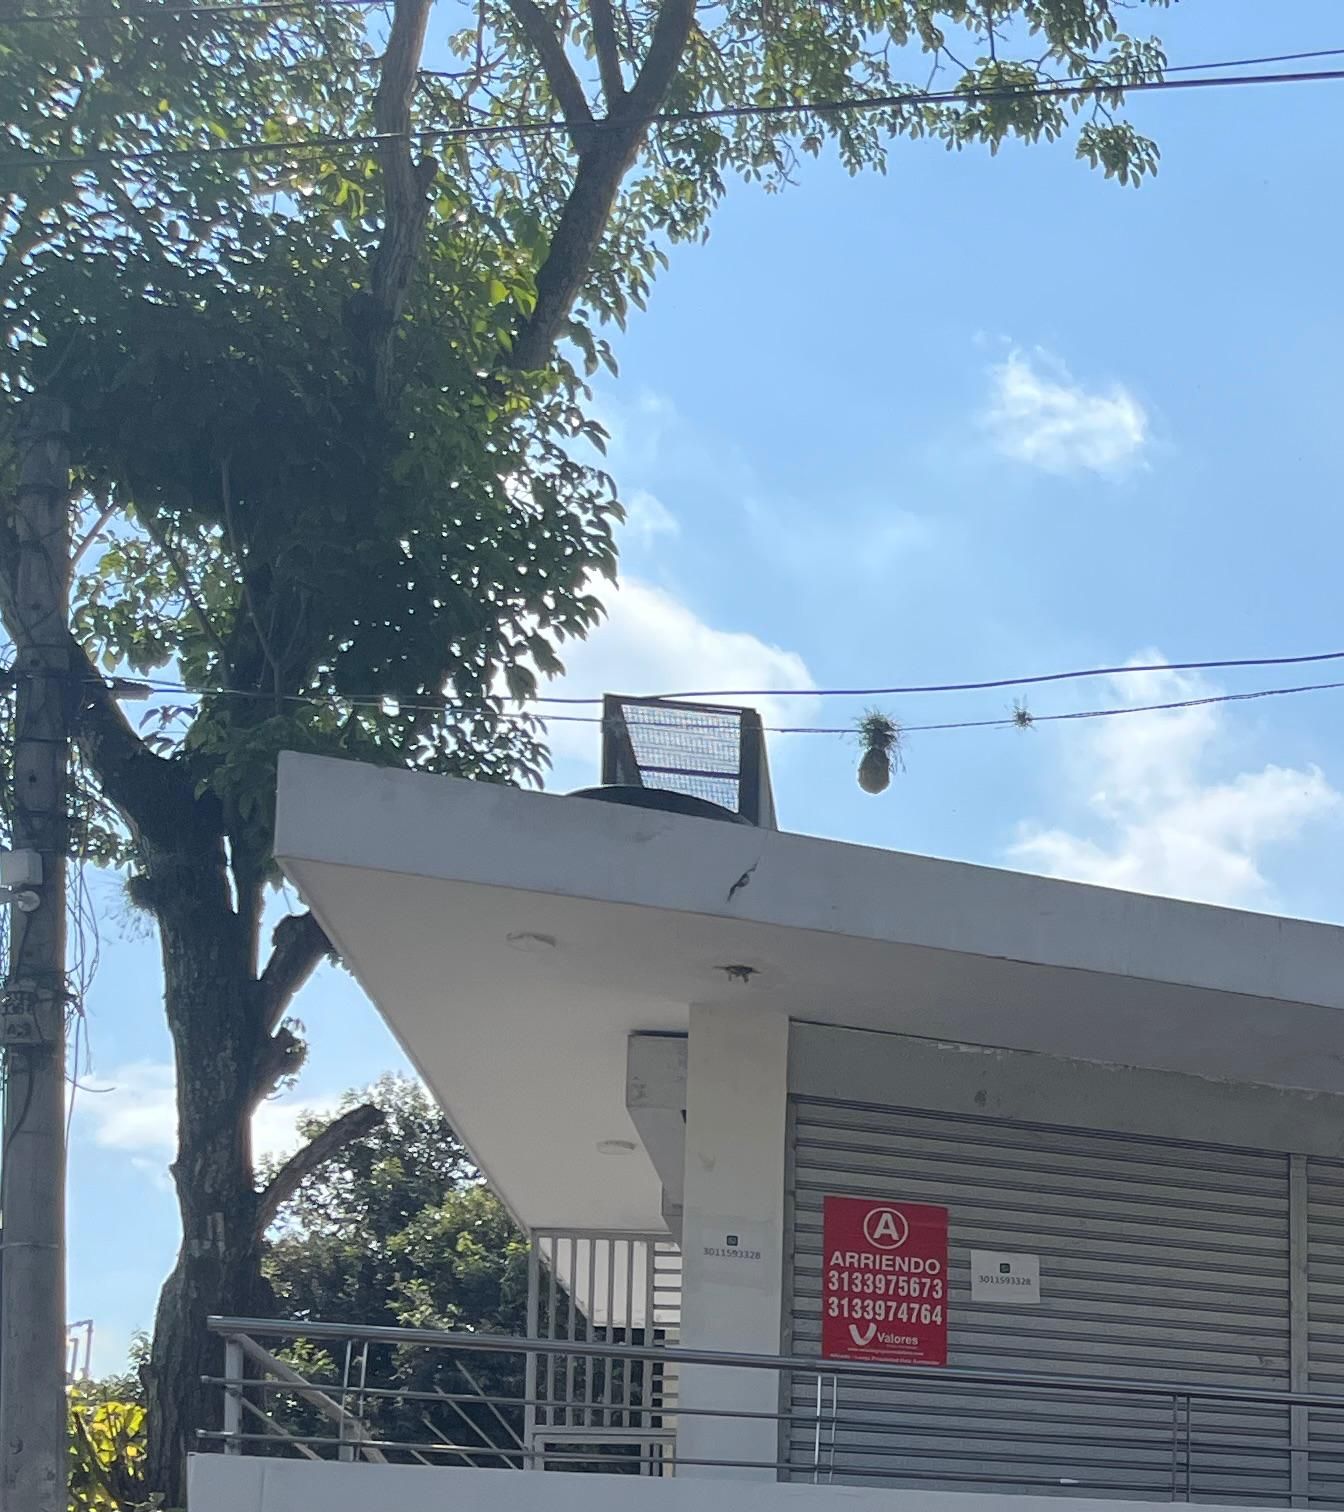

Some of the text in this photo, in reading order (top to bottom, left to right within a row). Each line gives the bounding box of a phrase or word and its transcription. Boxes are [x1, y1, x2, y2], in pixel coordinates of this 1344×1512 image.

[872, 1212, 900, 1241] A
[829, 1250, 941, 1275] ARRIENDO
[827, 1270, 943, 1299] 3133975673
[827, 1296, 943, 1326] 3133974764
[877, 1331, 919, 1346] Valores
